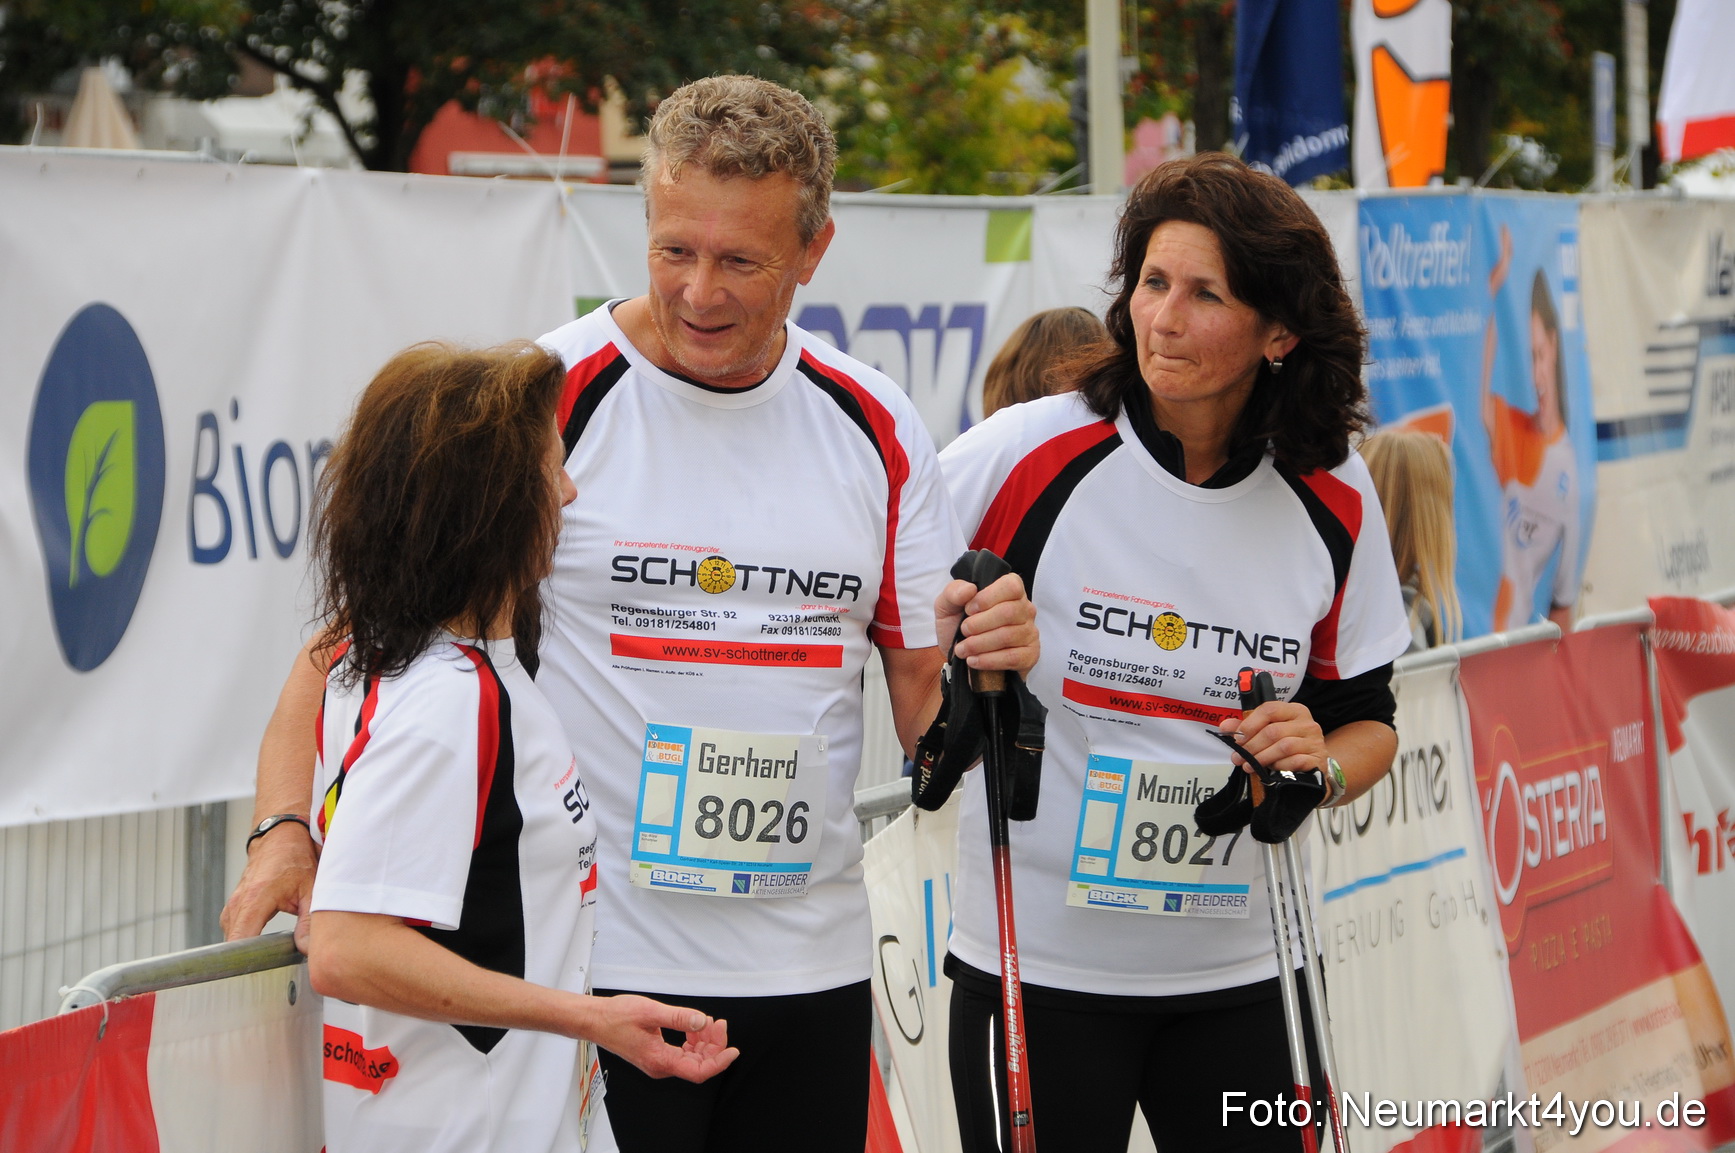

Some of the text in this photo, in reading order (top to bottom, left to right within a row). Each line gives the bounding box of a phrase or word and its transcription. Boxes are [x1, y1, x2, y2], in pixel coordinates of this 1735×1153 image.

[624, 540, 669, 550] kompetenter
[611, 555, 863, 602] SCHOTTNER
[611, 604, 738, 620] Regensburger Str. 92
[768, 614, 801, 623] 92318
[612, 616, 717, 631] Tel. 09181/254801
[760, 624, 842, 637] Fax 09181/254803
[1076, 602, 1301, 665] SCHOTTNER
[662, 645, 807, 662] www.sv-schottner.de
[1069, 649, 1186, 680] Regensburger Str. 92
[1067, 661, 1163, 689] Tel. 09181/254801
[1203, 686, 1223, 698] Fax
[1109, 695, 1240, 722] www.sv-schottnerde
[698, 742, 798, 780] Gerhard
[1137, 773, 1215, 806] Monika
[694, 794, 810, 844] 8026
[1131, 821, 1244, 866] 8027
[651, 870, 705, 885] BOCK
[752, 873, 808, 887] PFLEIDERER
[1088, 889, 1137, 903] BOCK
[1185, 894, 1248, 907] PFLEIDERER
[1531, 932, 1568, 973] PIZZA
[1584, 914, 1613, 950] PASTA
